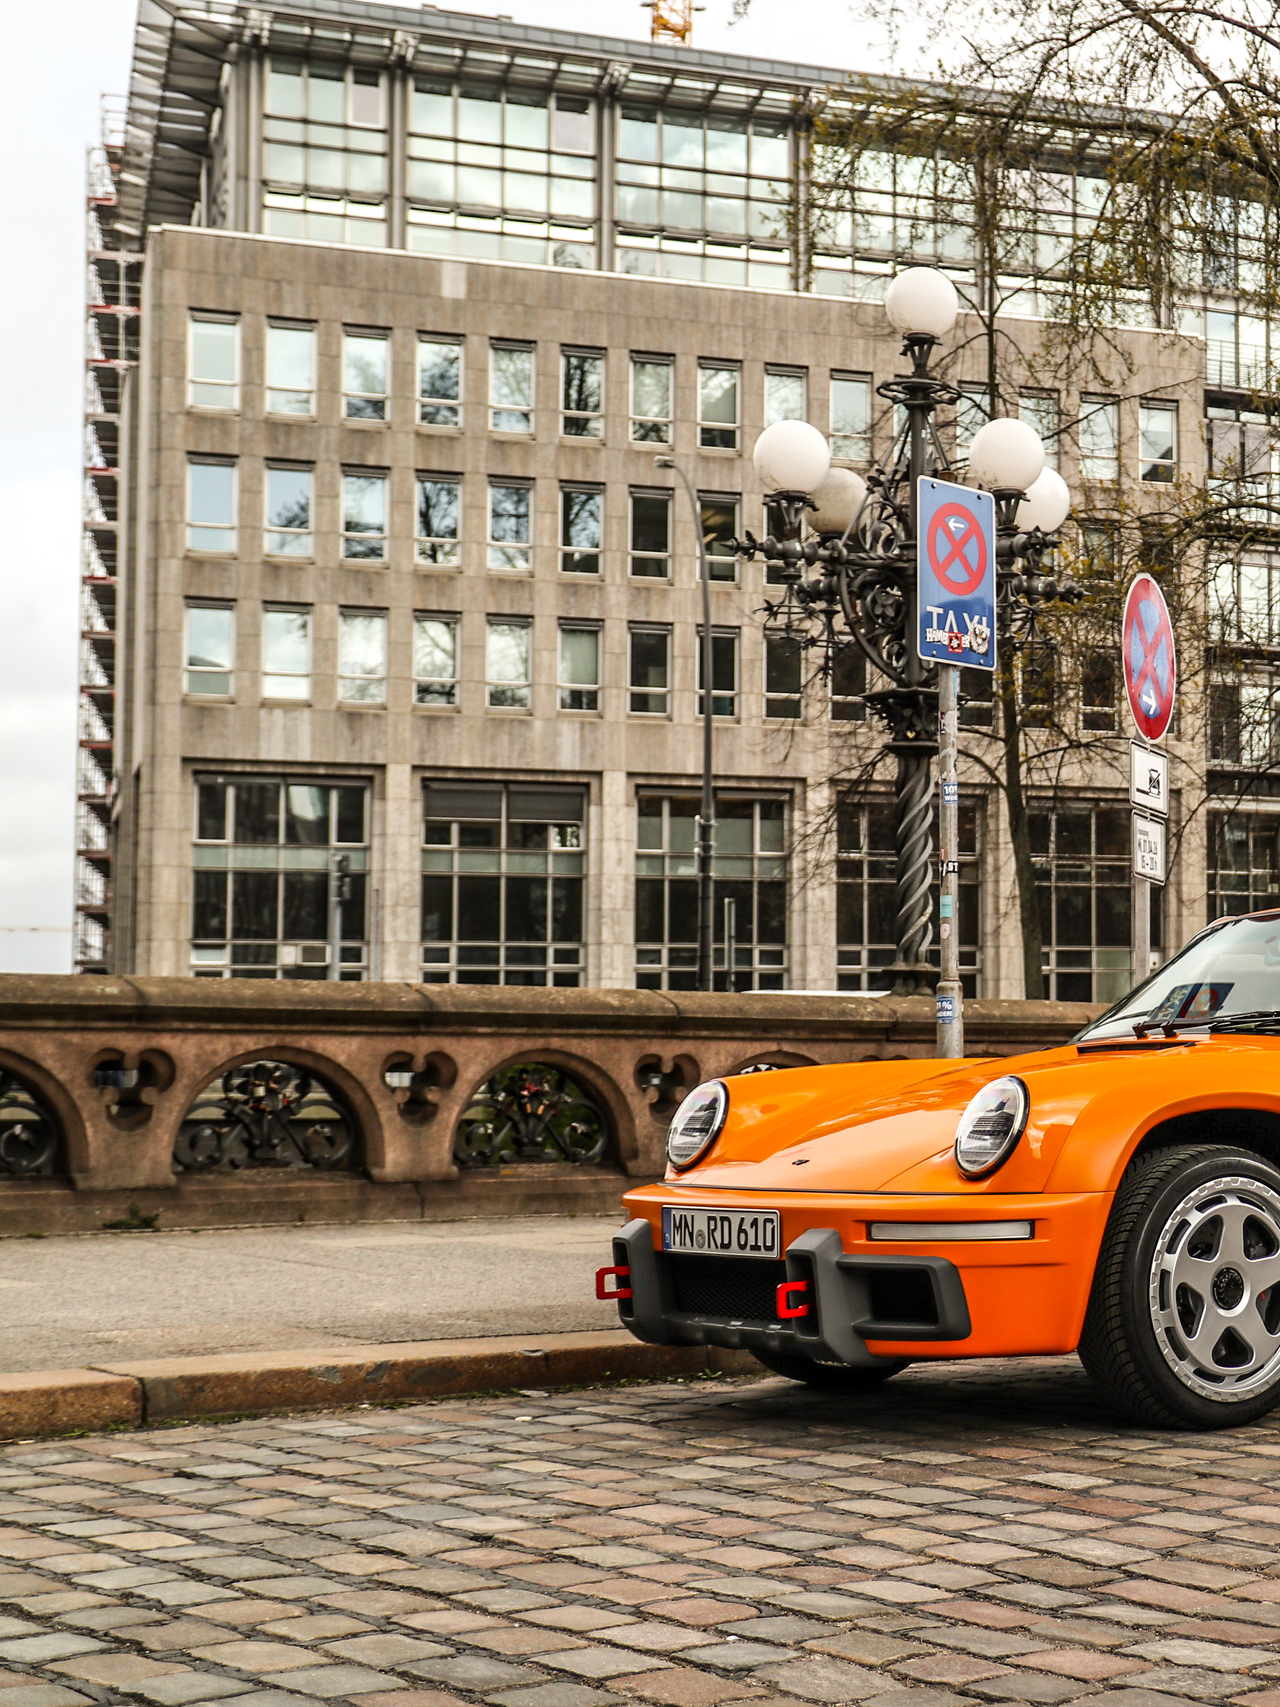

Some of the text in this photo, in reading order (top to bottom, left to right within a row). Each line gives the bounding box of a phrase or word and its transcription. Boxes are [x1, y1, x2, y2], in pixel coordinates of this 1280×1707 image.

[673, 1213, 694, 1248] MN
[707, 1215, 732, 1250] RD
[737, 1216, 776, 1252] 610
